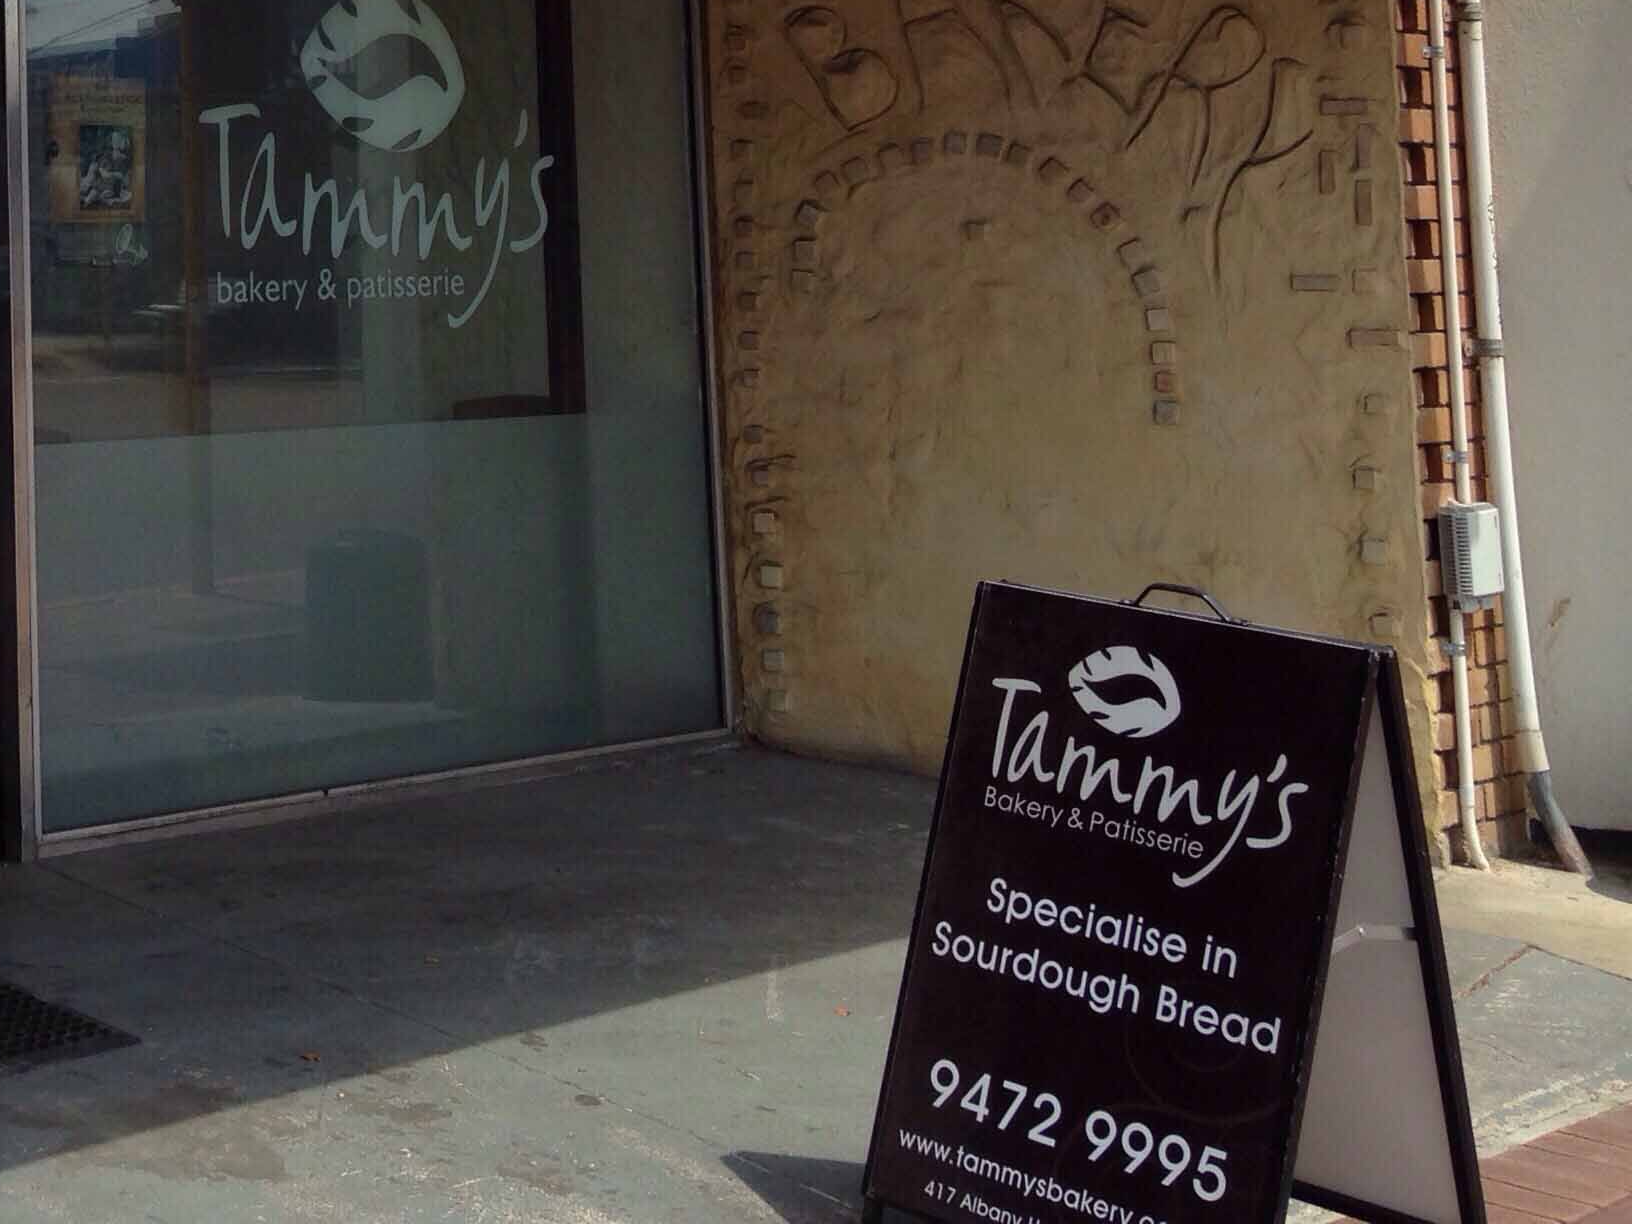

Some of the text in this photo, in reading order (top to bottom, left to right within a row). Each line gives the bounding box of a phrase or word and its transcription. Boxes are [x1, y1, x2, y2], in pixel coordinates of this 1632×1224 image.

[199, 103, 555, 328] Tammy's
[216, 268, 465, 310] bakery & patisserie
[983, 785, 1205, 859] Bakery & Patisserie
[991, 677, 1309, 888] Tammy's
[986, 877, 1239, 979] Specialise in
[931, 921, 1282, 1055] Sourdough Bread
[930, 1059, 1228, 1203] 9472 9995
[924, 1180, 957, 1205] 417
